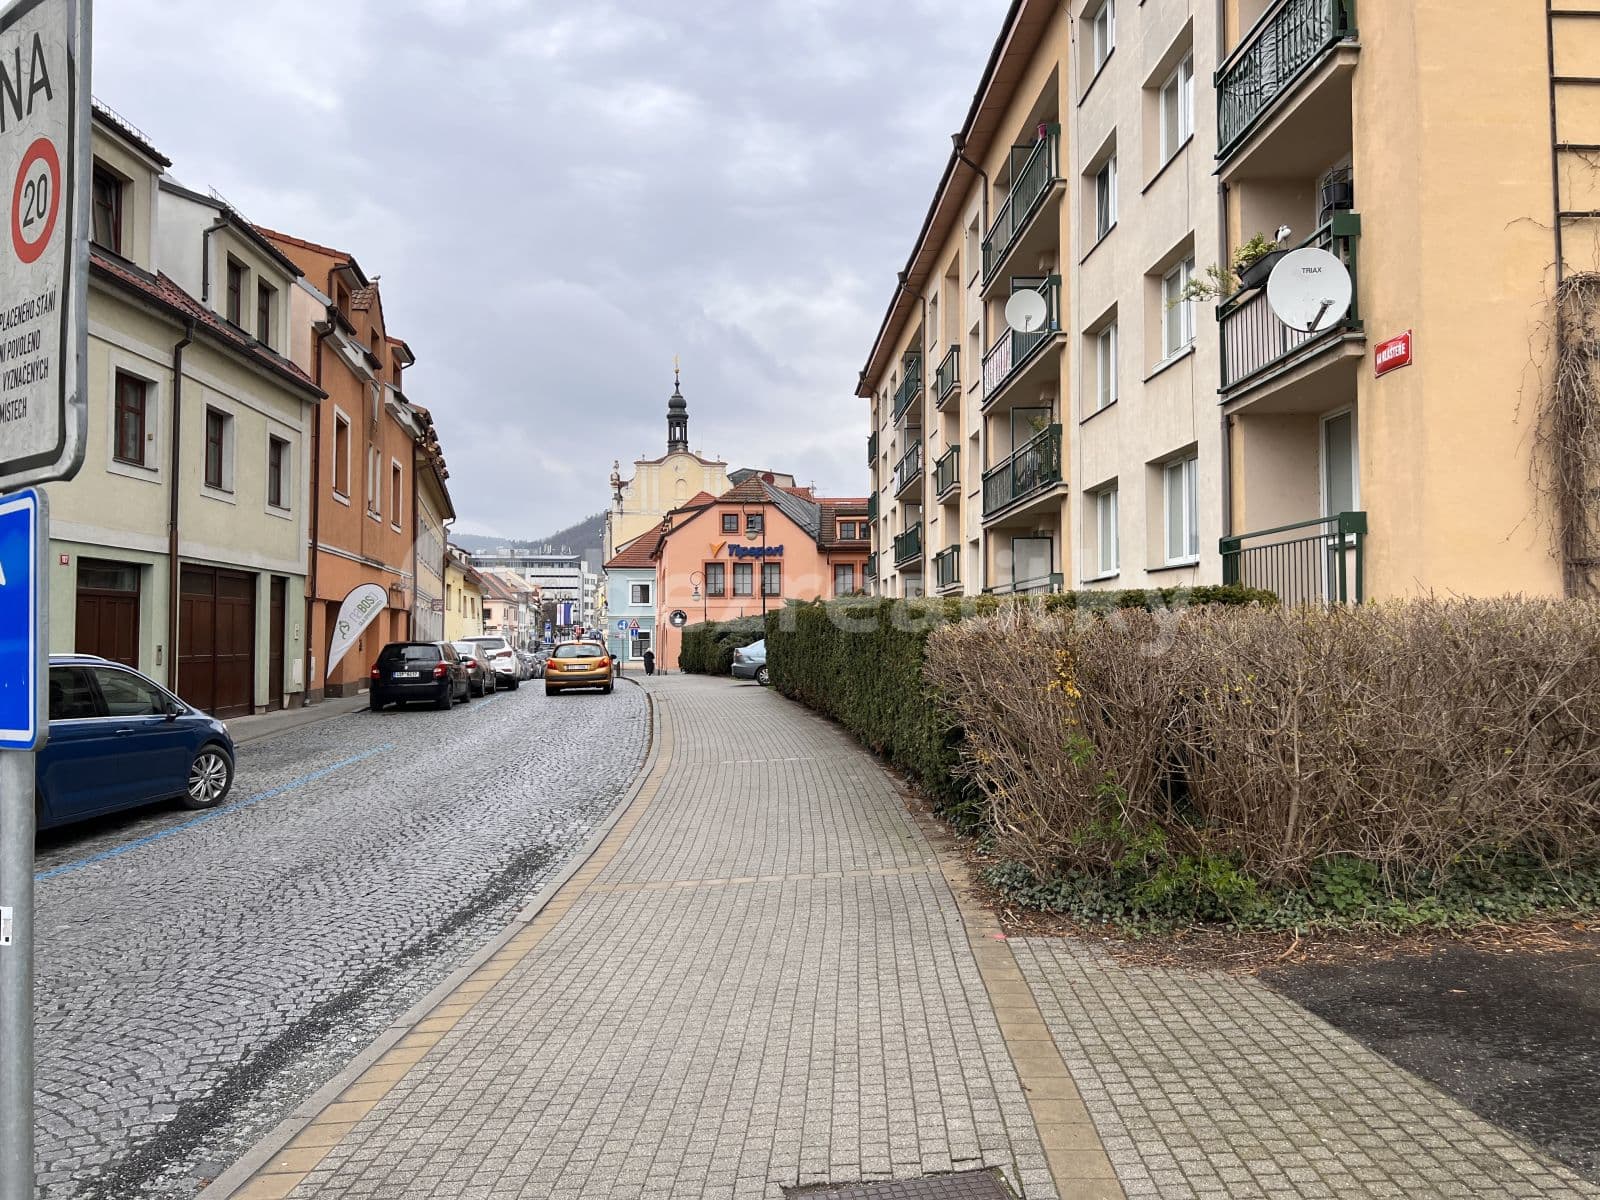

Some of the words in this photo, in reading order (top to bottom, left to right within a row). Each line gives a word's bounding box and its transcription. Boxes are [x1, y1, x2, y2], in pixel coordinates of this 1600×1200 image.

[23, 173, 48, 228] 20
[35, 285, 56, 317] STÁNÍ
[7, 329, 40, 361] POVOLENO
[2, 356, 49, 391] VYZNAČENÝCH
[728, 544, 784, 560] Tipsport
